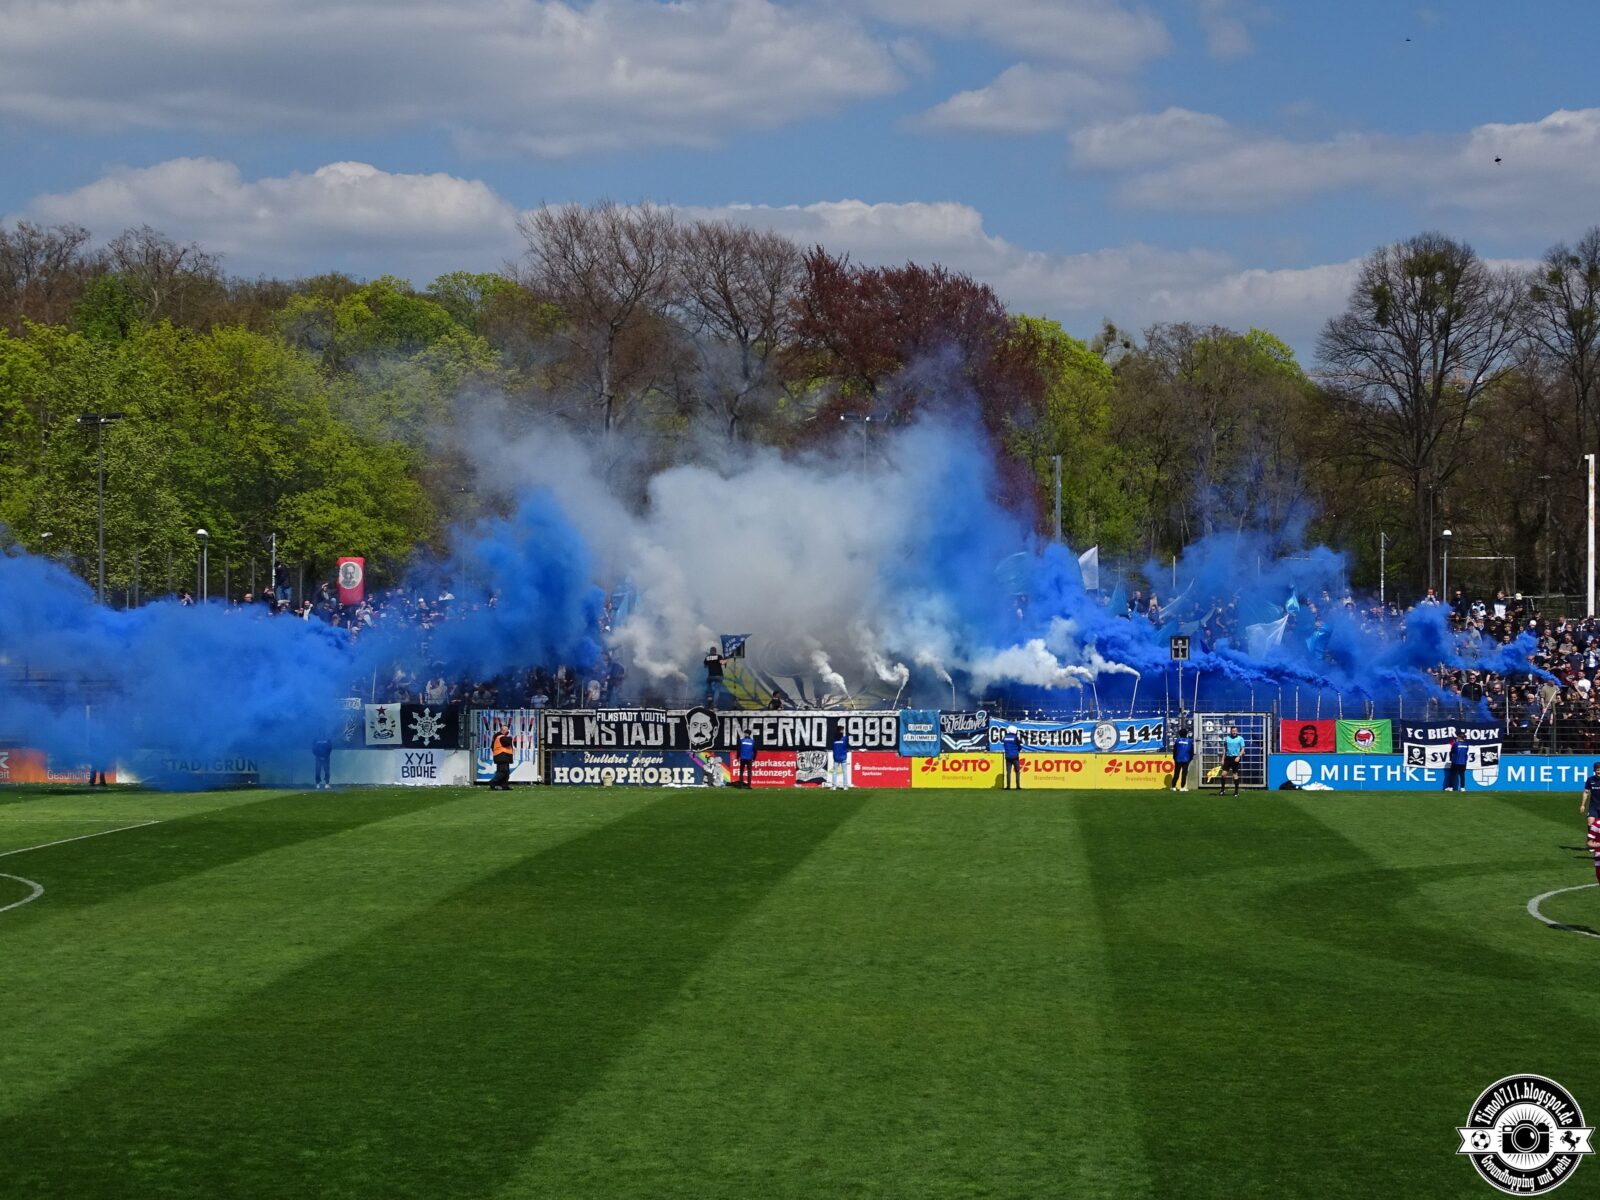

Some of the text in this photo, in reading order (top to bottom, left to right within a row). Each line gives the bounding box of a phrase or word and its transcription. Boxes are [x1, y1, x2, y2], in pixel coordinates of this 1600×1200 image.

[597, 711, 637, 723] FILMSTADT
[641, 711, 667, 723] YOUTH
[546, 717, 897, 748] FILMSTADT INFERNO 1999
[990, 723, 1164, 747] CONECTION 144
[1406, 727, 1423, 739] FC
[1428, 726, 1457, 740] BIER
[404, 751, 434, 765] ХУЙ
[632, 754, 664, 767] gegen
[401, 765, 437, 779] ВОЙНЕ
[941, 759, 991, 772] LOTTO
[1034, 760, 1083, 773] LOTTO
[1125, 760, 1174, 773] LOTTO
[47, 769, 91, 780] Gesundhe
[553, 767, 695, 784] HOMOPHOBIE
[1320, 764, 1437, 782] MIETHKE
[1507, 765, 1588, 782] MIETH
